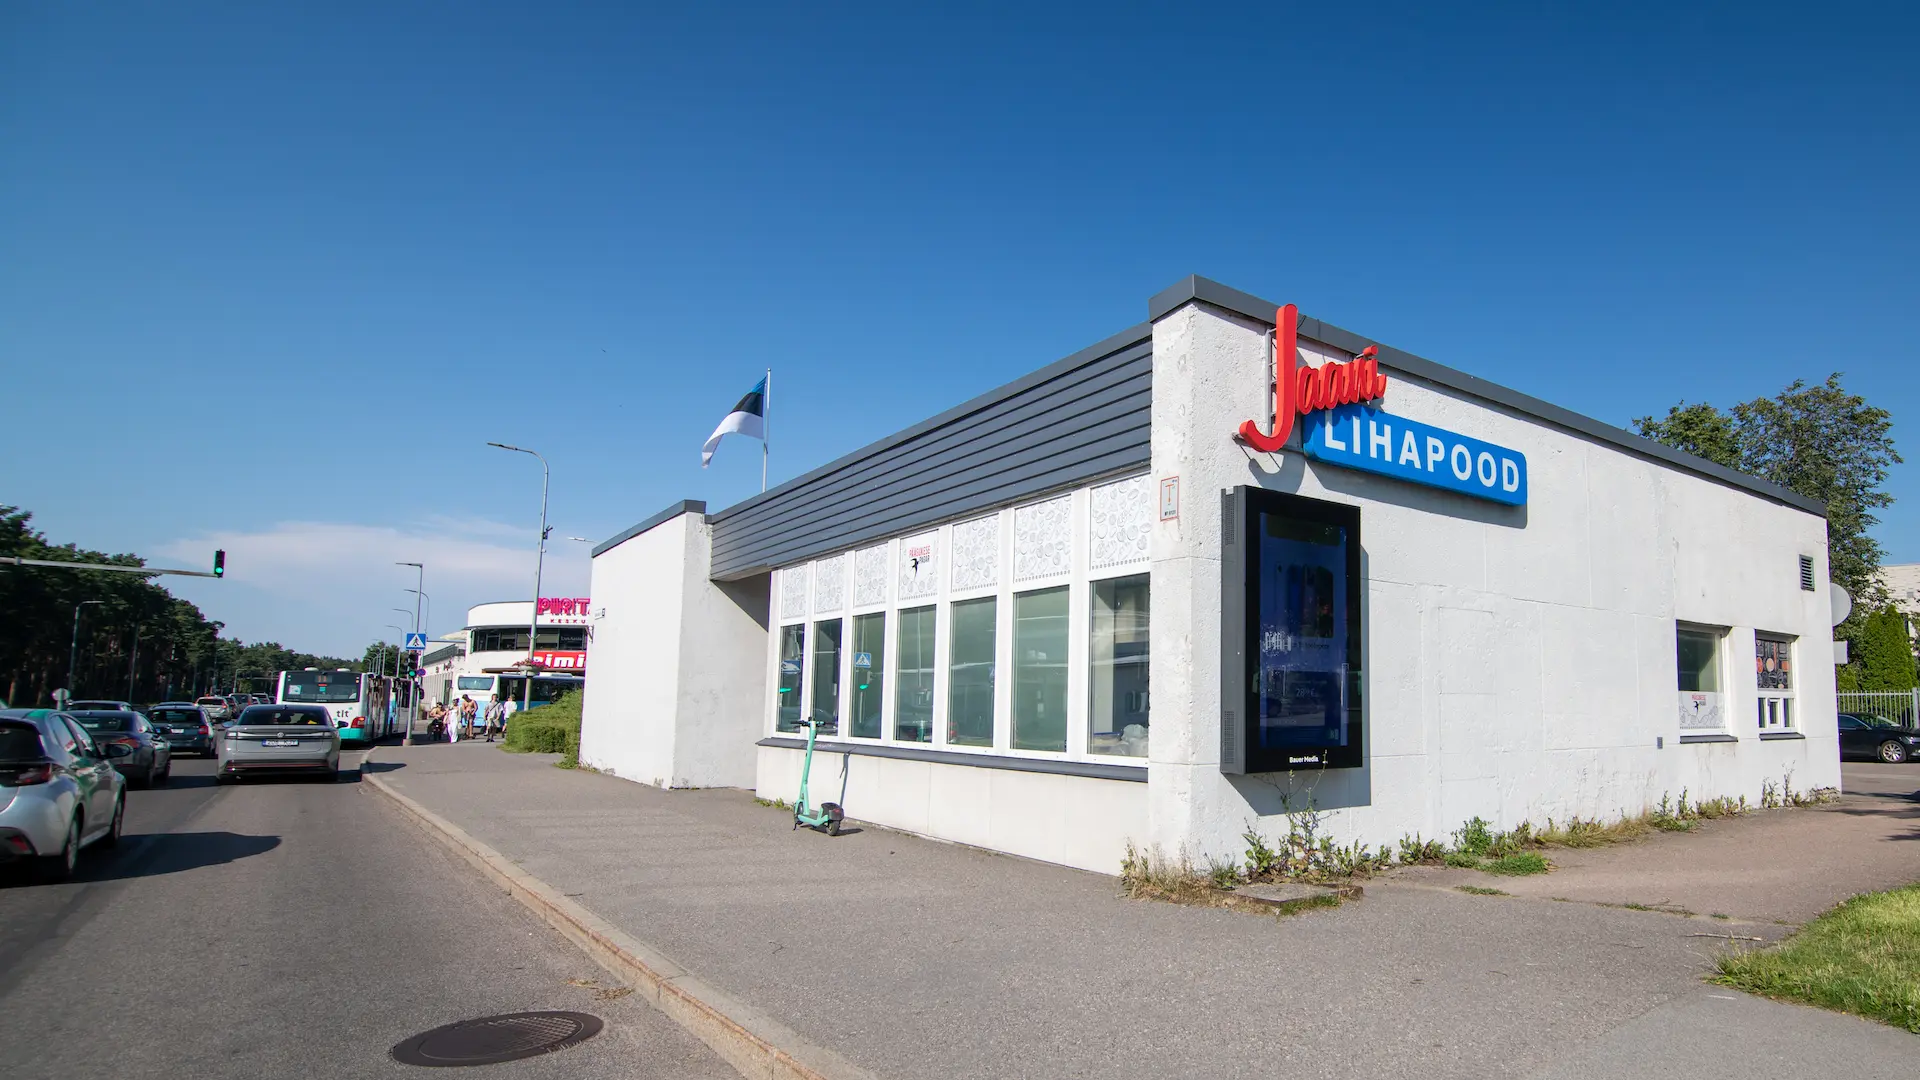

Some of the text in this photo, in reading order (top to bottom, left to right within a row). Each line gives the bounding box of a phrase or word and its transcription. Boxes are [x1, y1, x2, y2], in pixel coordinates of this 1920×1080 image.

[1239, 303, 1387, 452] Jaani
[1325, 411, 1520, 493] LIHAPOOD
[537, 598, 590, 616] PIRIT
[336, 709, 350, 718] tlt
[1304, 755, 1319, 763] Media
